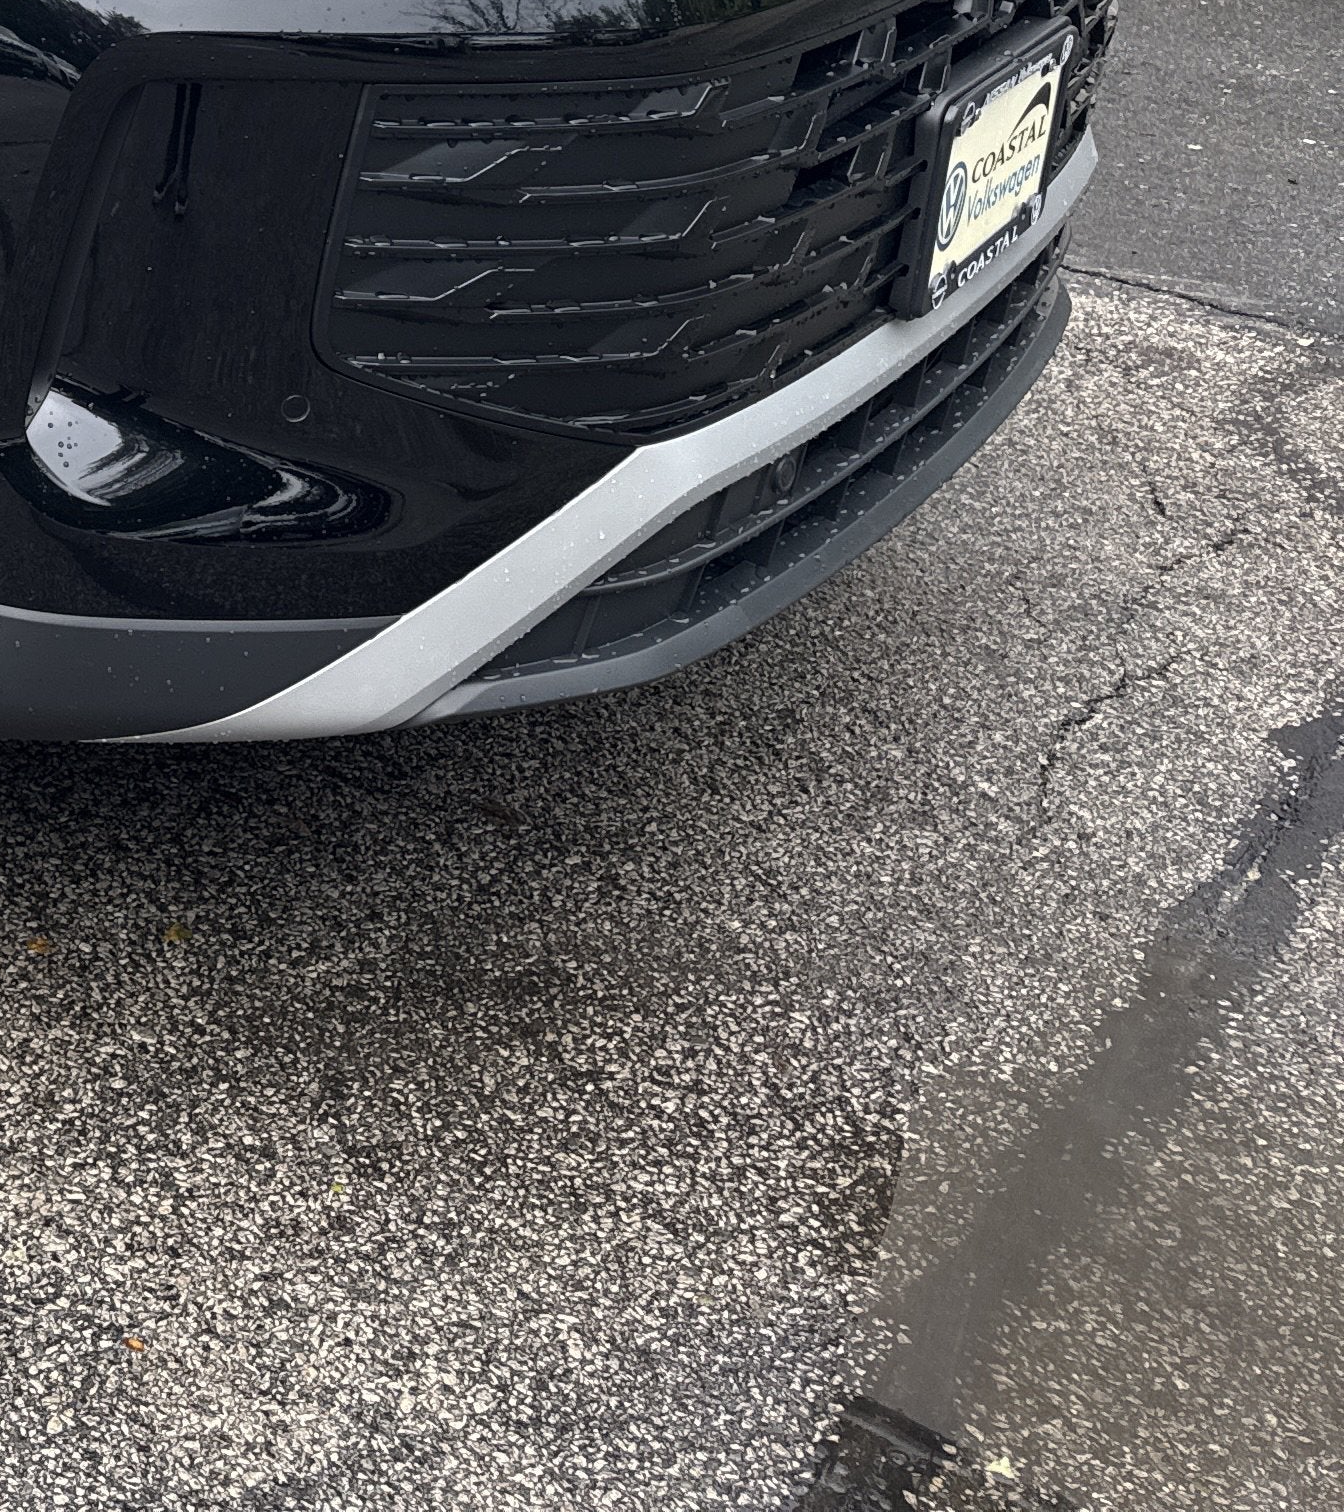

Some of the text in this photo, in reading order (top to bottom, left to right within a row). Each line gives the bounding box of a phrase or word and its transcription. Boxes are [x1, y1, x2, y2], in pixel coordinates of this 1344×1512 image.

[972, 114, 1046, 184] COASTAL
[967, 154, 1041, 227] Volkswagen
[958, 226, 1018, 287] COASTAL
